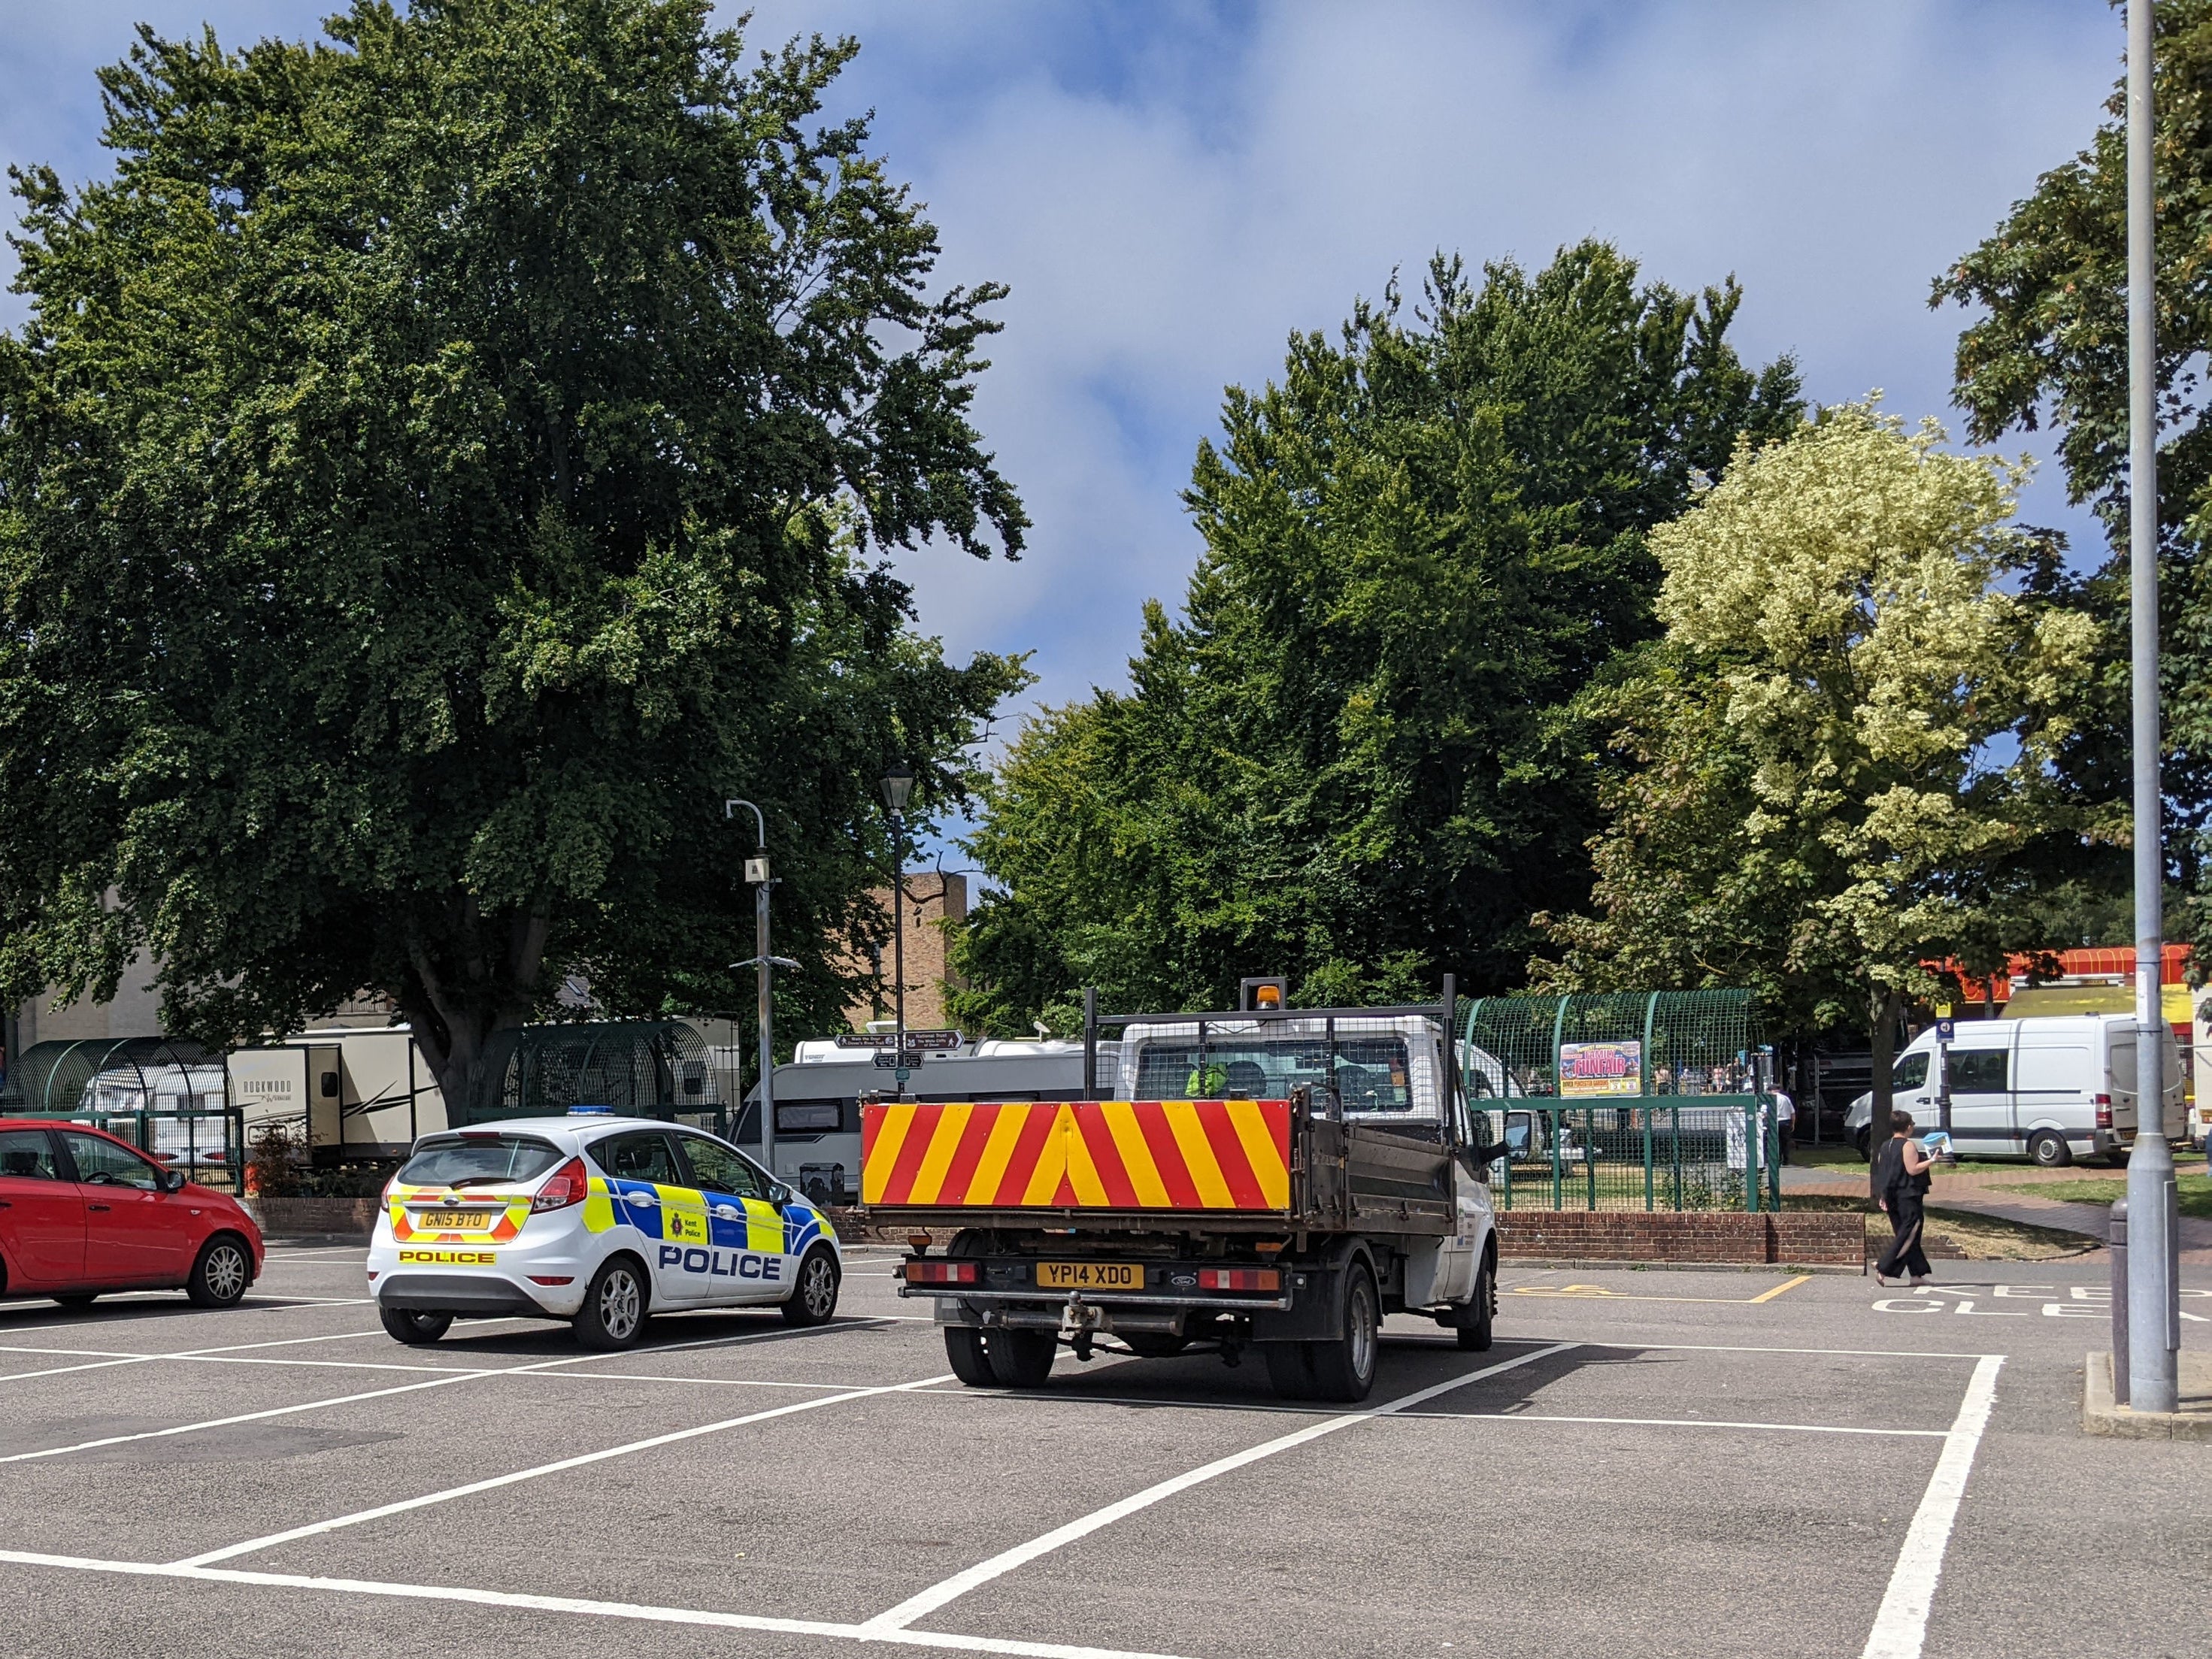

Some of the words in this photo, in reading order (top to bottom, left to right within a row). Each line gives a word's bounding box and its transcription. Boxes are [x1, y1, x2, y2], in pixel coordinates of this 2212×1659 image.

[1584, 1049, 1616, 1058] FAMILY
[1574, 1058, 1626, 1074] FUNFAIR
[244, 1080, 291, 1092] ROCKWOOD
[685, 1229, 701, 1237] Police
[399, 1252, 495, 1263] POLICE
[659, 1245, 781, 1280] POLICE
[1049, 1265, 1089, 1283] YP14
[1095, 1266, 1132, 1284] XDO
